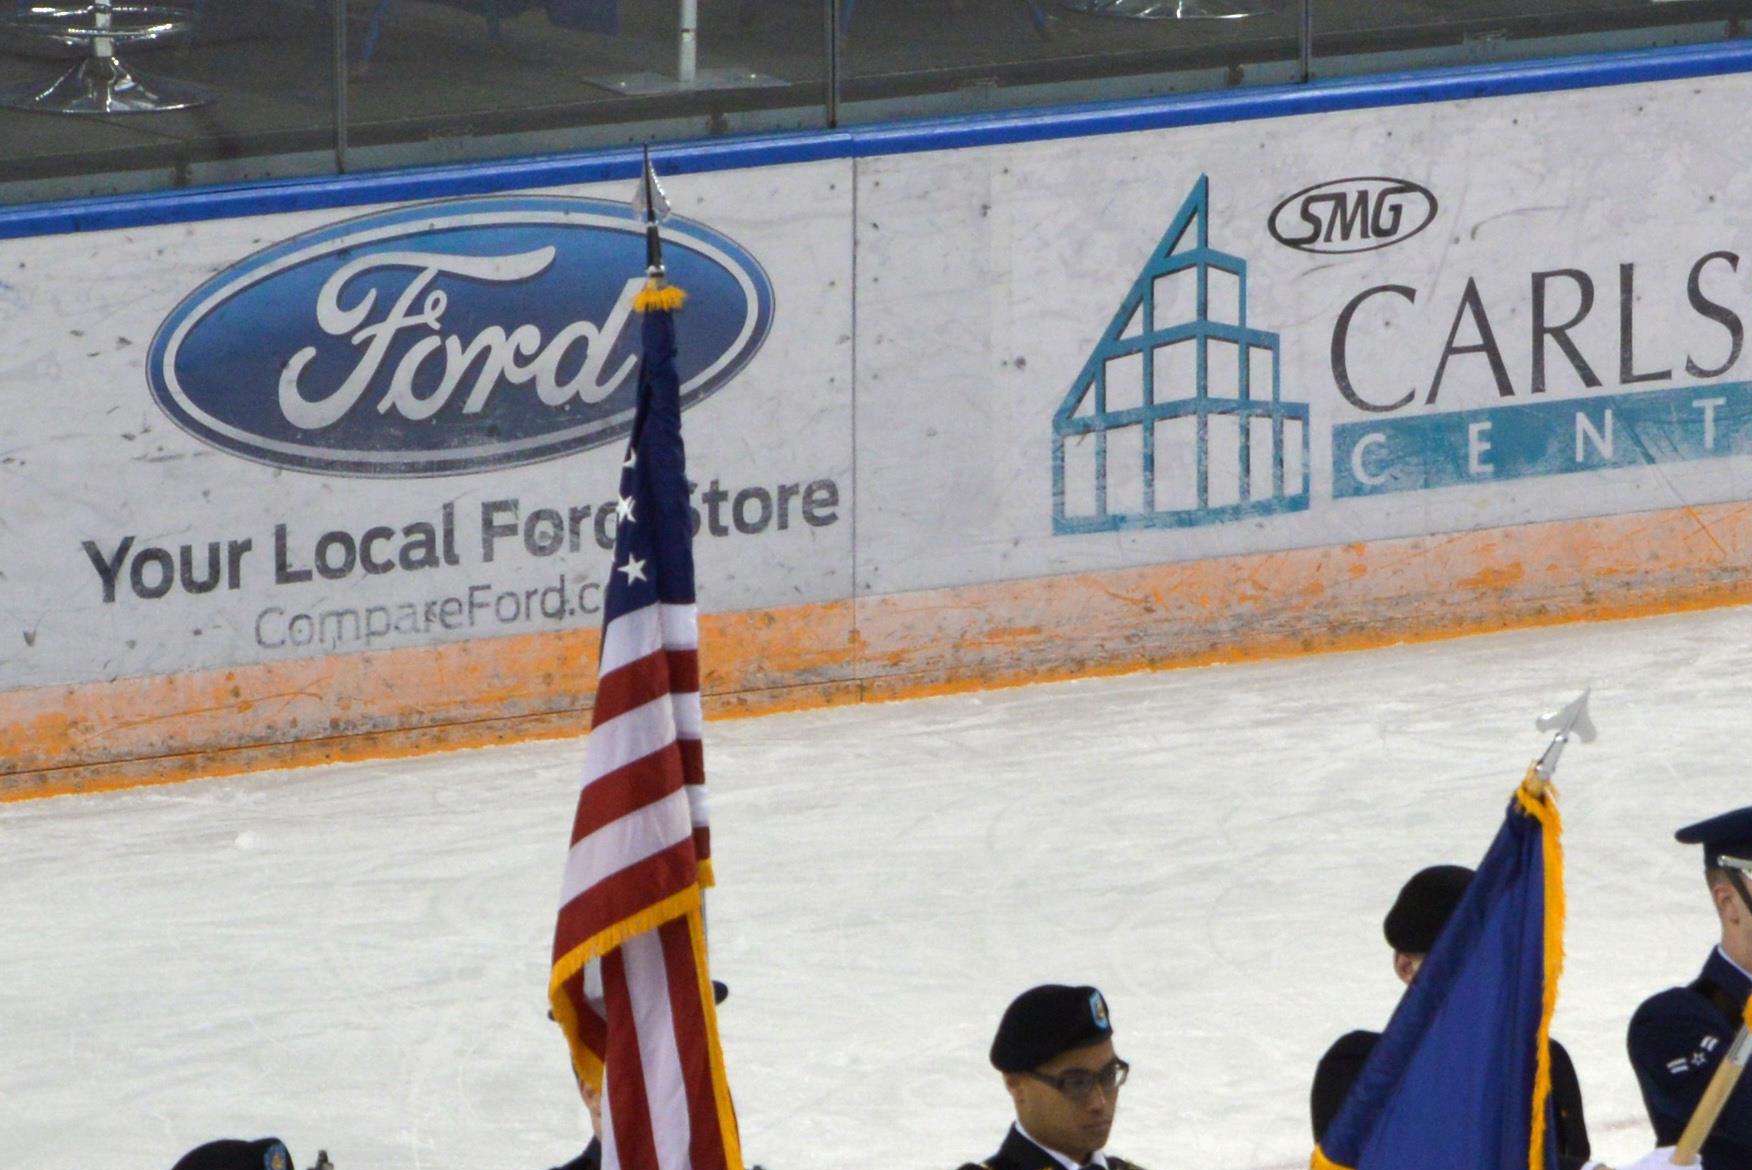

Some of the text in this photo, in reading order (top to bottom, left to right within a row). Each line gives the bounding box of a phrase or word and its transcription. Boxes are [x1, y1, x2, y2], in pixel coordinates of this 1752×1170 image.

[1285, 186, 1416, 246] SMG
[278, 245, 648, 430] Ford
[81, 536, 252, 603] Your
[274, 502, 460, 585] Local
[687, 478, 840, 538] tore
[255, 574, 602, 650] CompareFord.c
